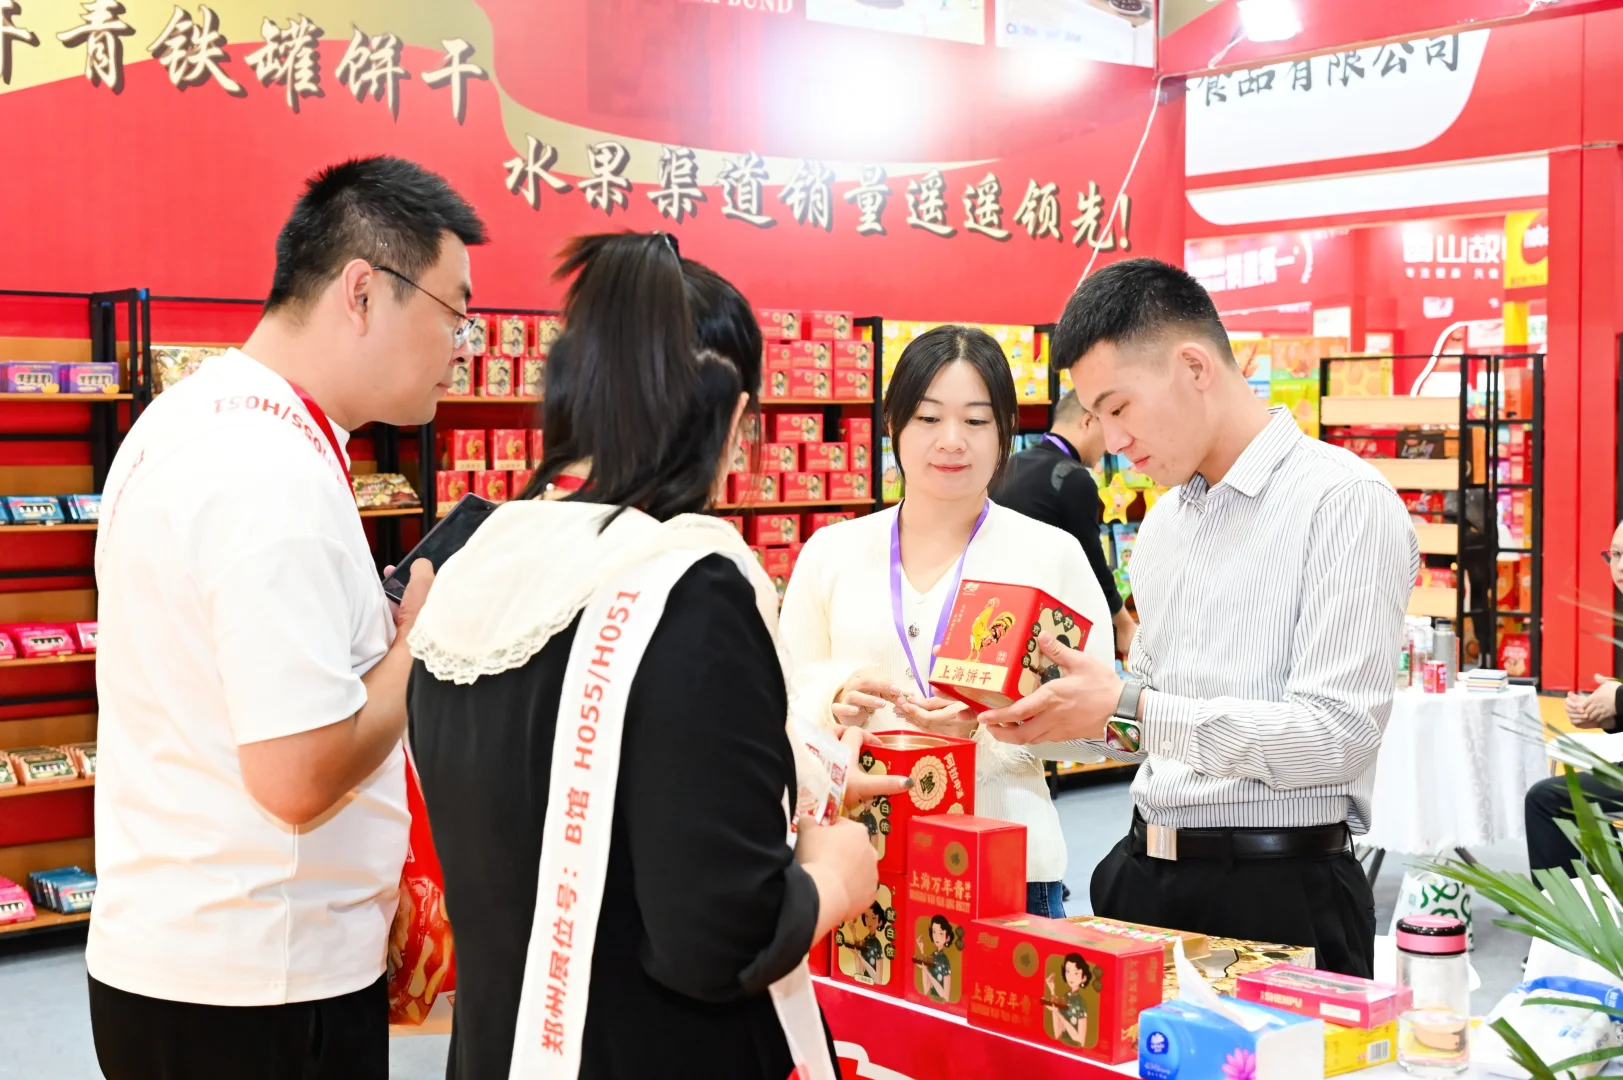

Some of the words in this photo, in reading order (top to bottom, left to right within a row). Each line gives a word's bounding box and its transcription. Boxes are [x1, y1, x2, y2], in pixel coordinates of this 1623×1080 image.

[503, 134, 1133, 251] 水果渠道销量遥遥领先!
[574, 590, 641, 770] H055/H051
[938, 665, 992, 687] 上海饼干
[565, 787, 590, 845] B馆
